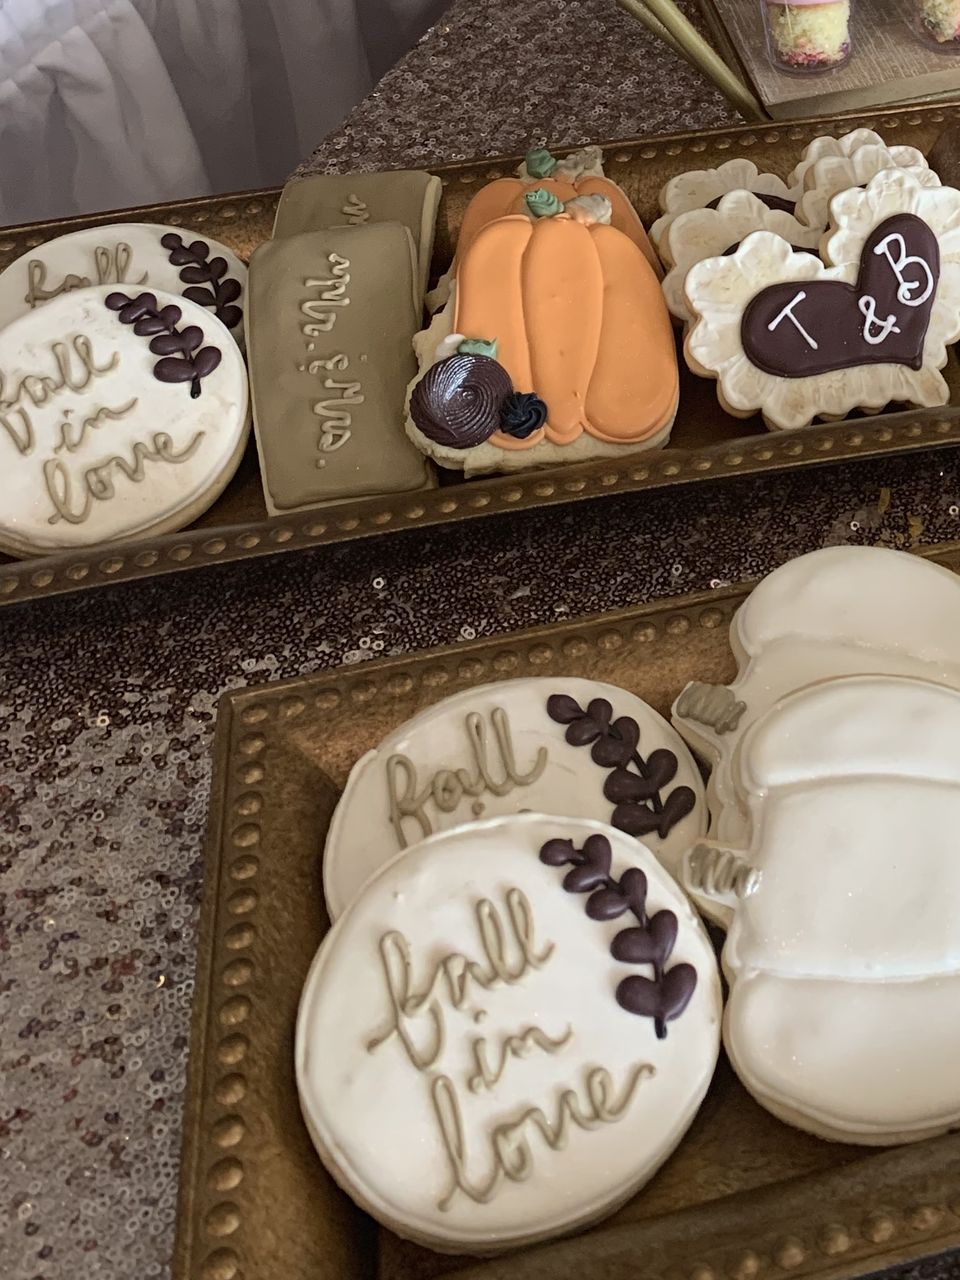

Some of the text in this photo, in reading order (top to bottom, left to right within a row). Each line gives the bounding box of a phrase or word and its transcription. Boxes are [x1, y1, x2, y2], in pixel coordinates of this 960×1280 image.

[767, 232, 935, 350] T & B
[43, 431, 206, 525] love
[53, 396, 139, 455] in
[386, 706, 549, 850] fall
[366, 886, 556, 1072] fall
[467, 1008, 573, 1094] in
[431, 1061, 656, 1212] love
